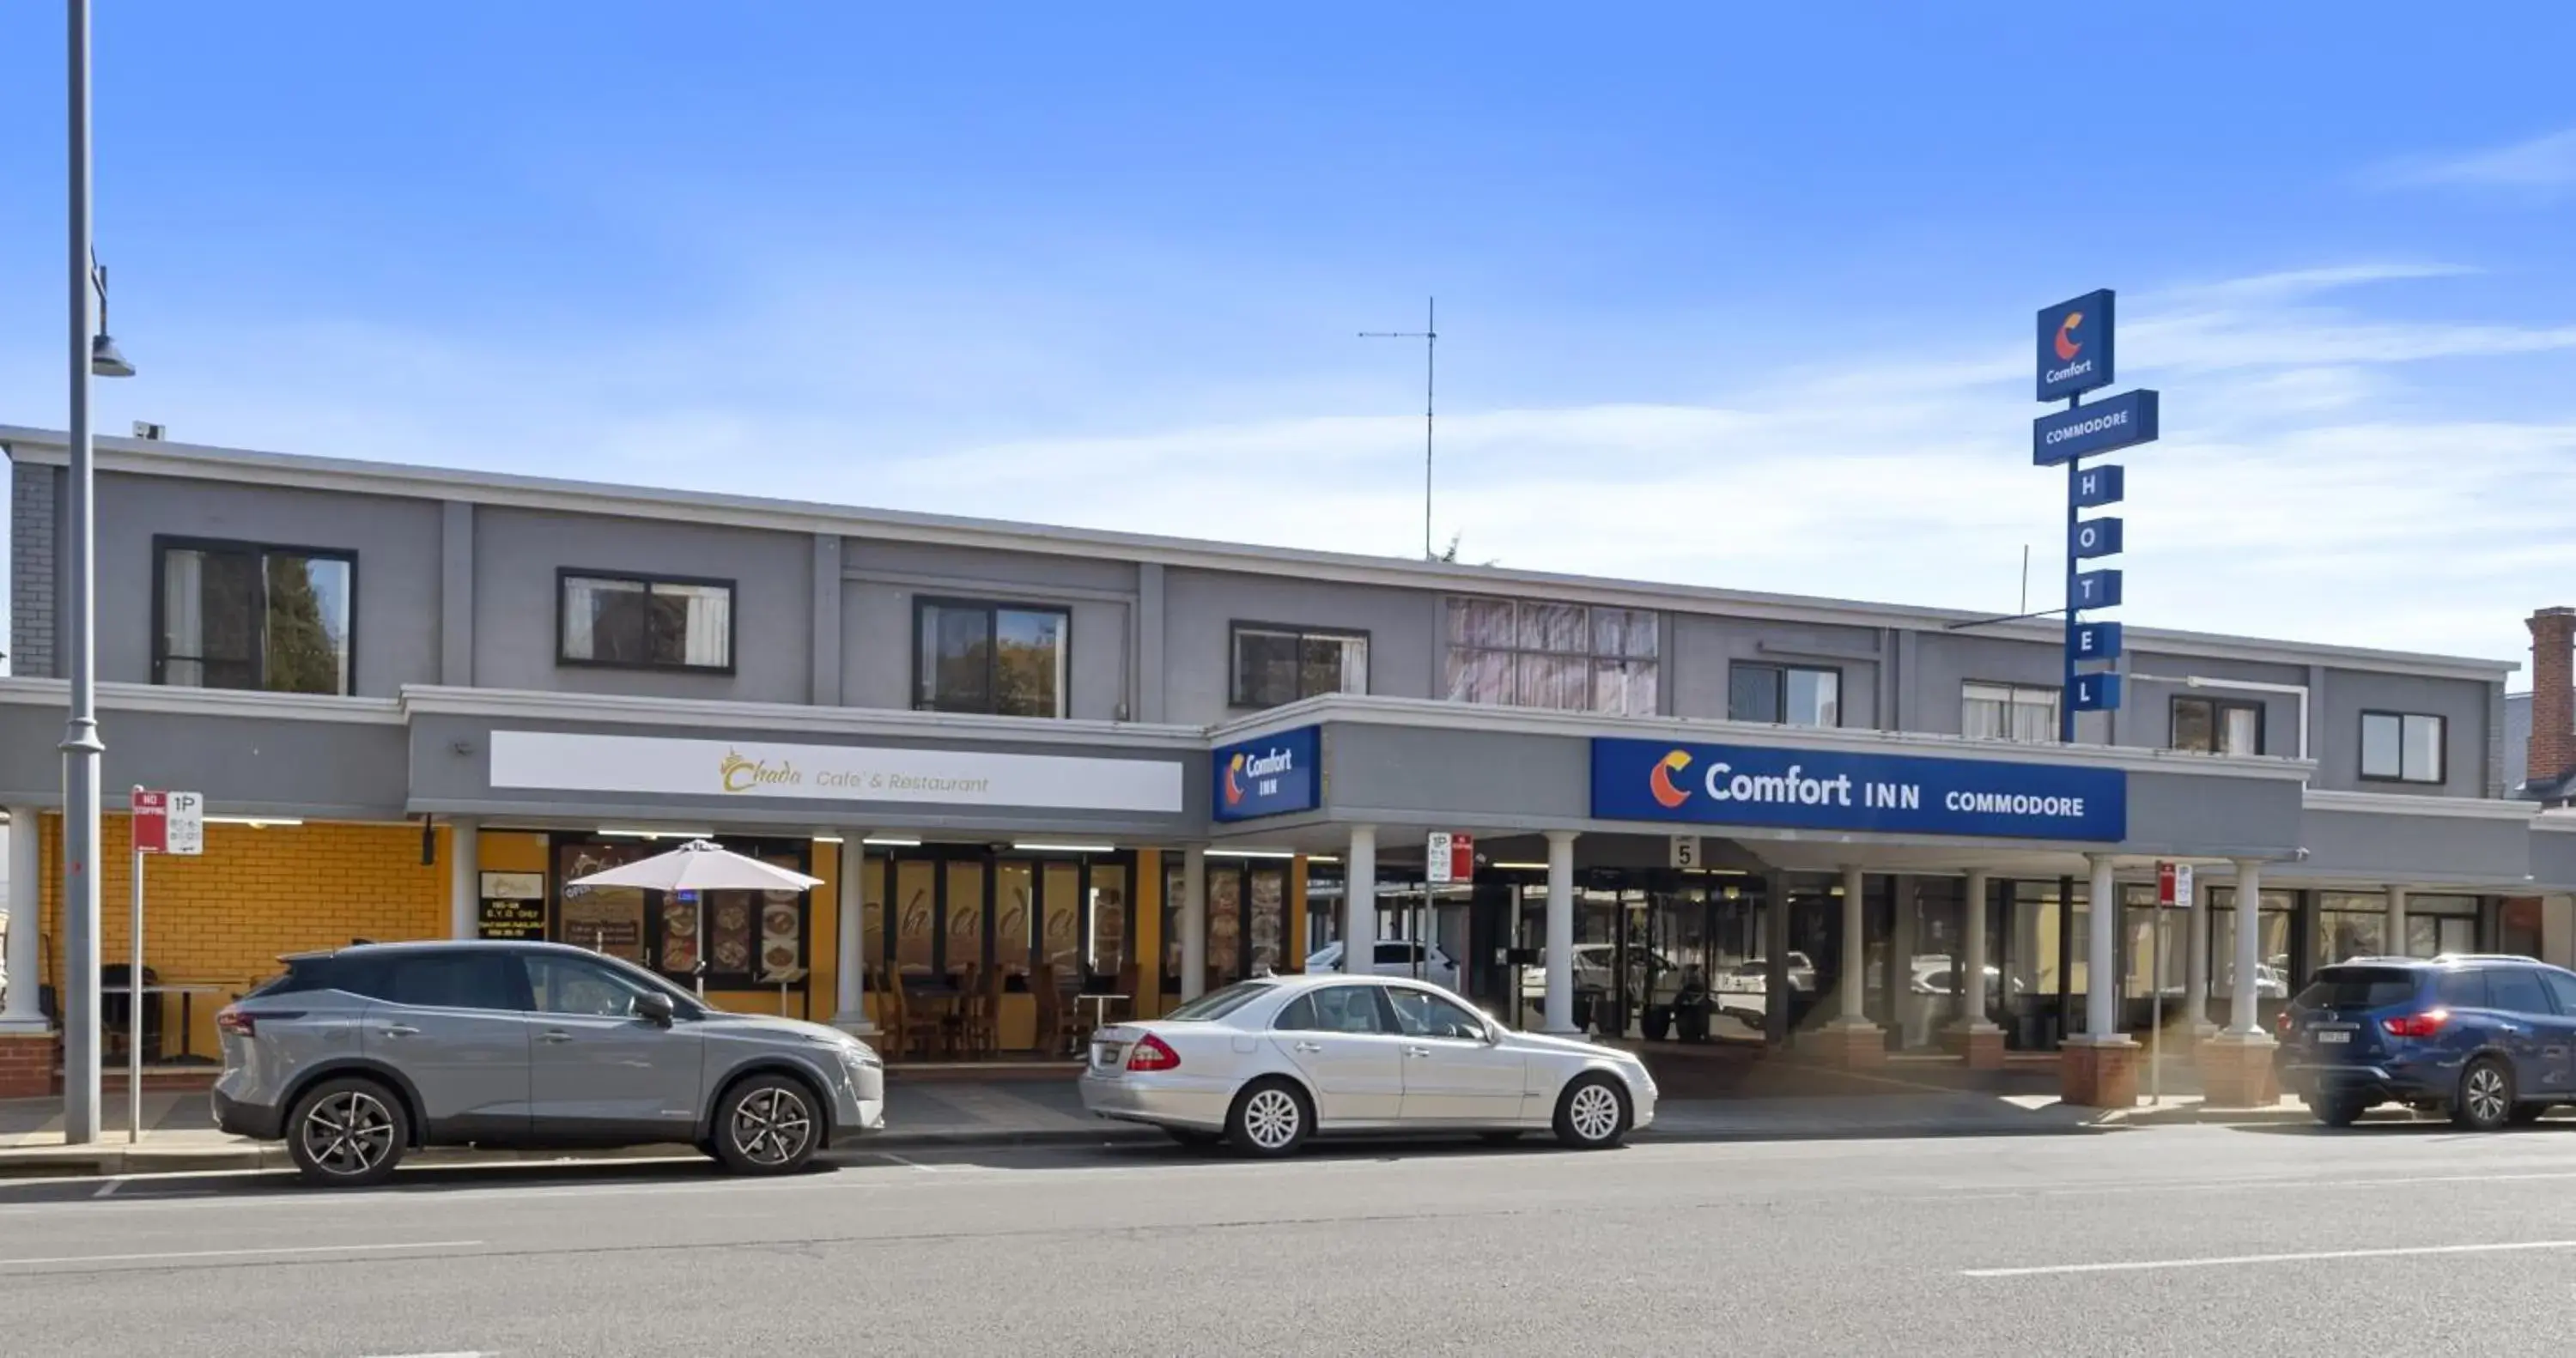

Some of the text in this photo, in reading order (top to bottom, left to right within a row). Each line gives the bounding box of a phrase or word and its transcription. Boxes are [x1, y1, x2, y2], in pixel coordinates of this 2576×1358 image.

[2046, 360, 2092, 384] Comfort
[2046, 410, 2129, 445] COMMODORE
[1246, 748, 1292, 779] Comfort
[870, 773, 883, 788] &
[890, 773, 990, 792] Restaurant
[1259, 778, 1277, 797] INN
[1705, 762, 2085, 816] Comfort INN COMMODORE
[143, 795, 157, 805] NO
[174, 795, 196, 813] 1P
[1679, 845, 1691, 865] 5
[565, 884, 592, 899] OPEN
